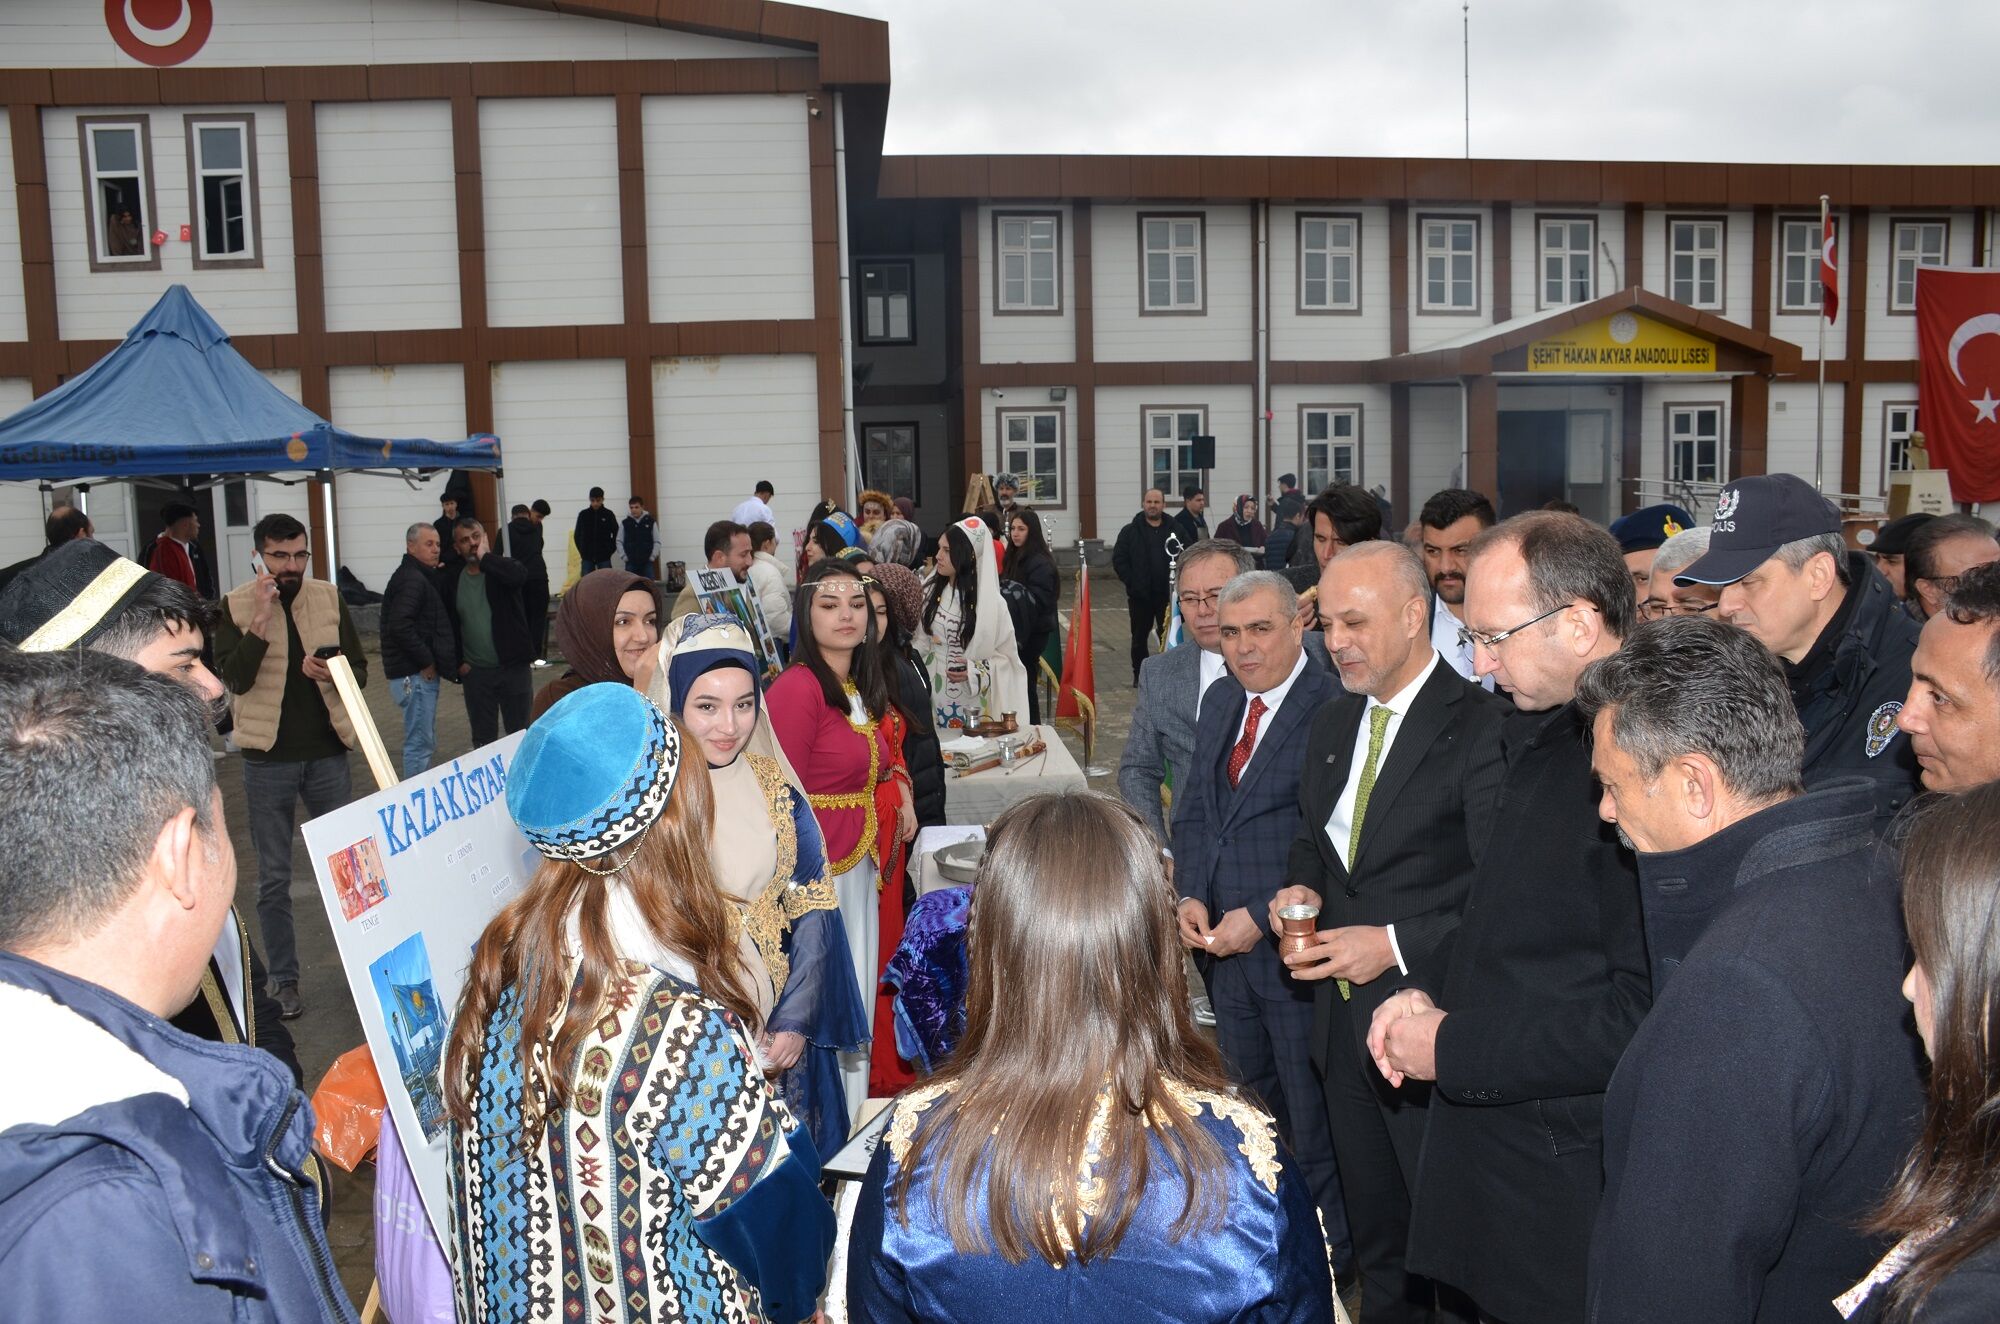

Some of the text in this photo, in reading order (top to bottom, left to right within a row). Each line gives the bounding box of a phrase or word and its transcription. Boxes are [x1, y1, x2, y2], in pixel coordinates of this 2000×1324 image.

[1533, 348, 1709, 368] ŞEHİT HAKAN AKYAR ANADOLU LİSESİ
[377, 753, 507, 857] KAZAKİSTAN
